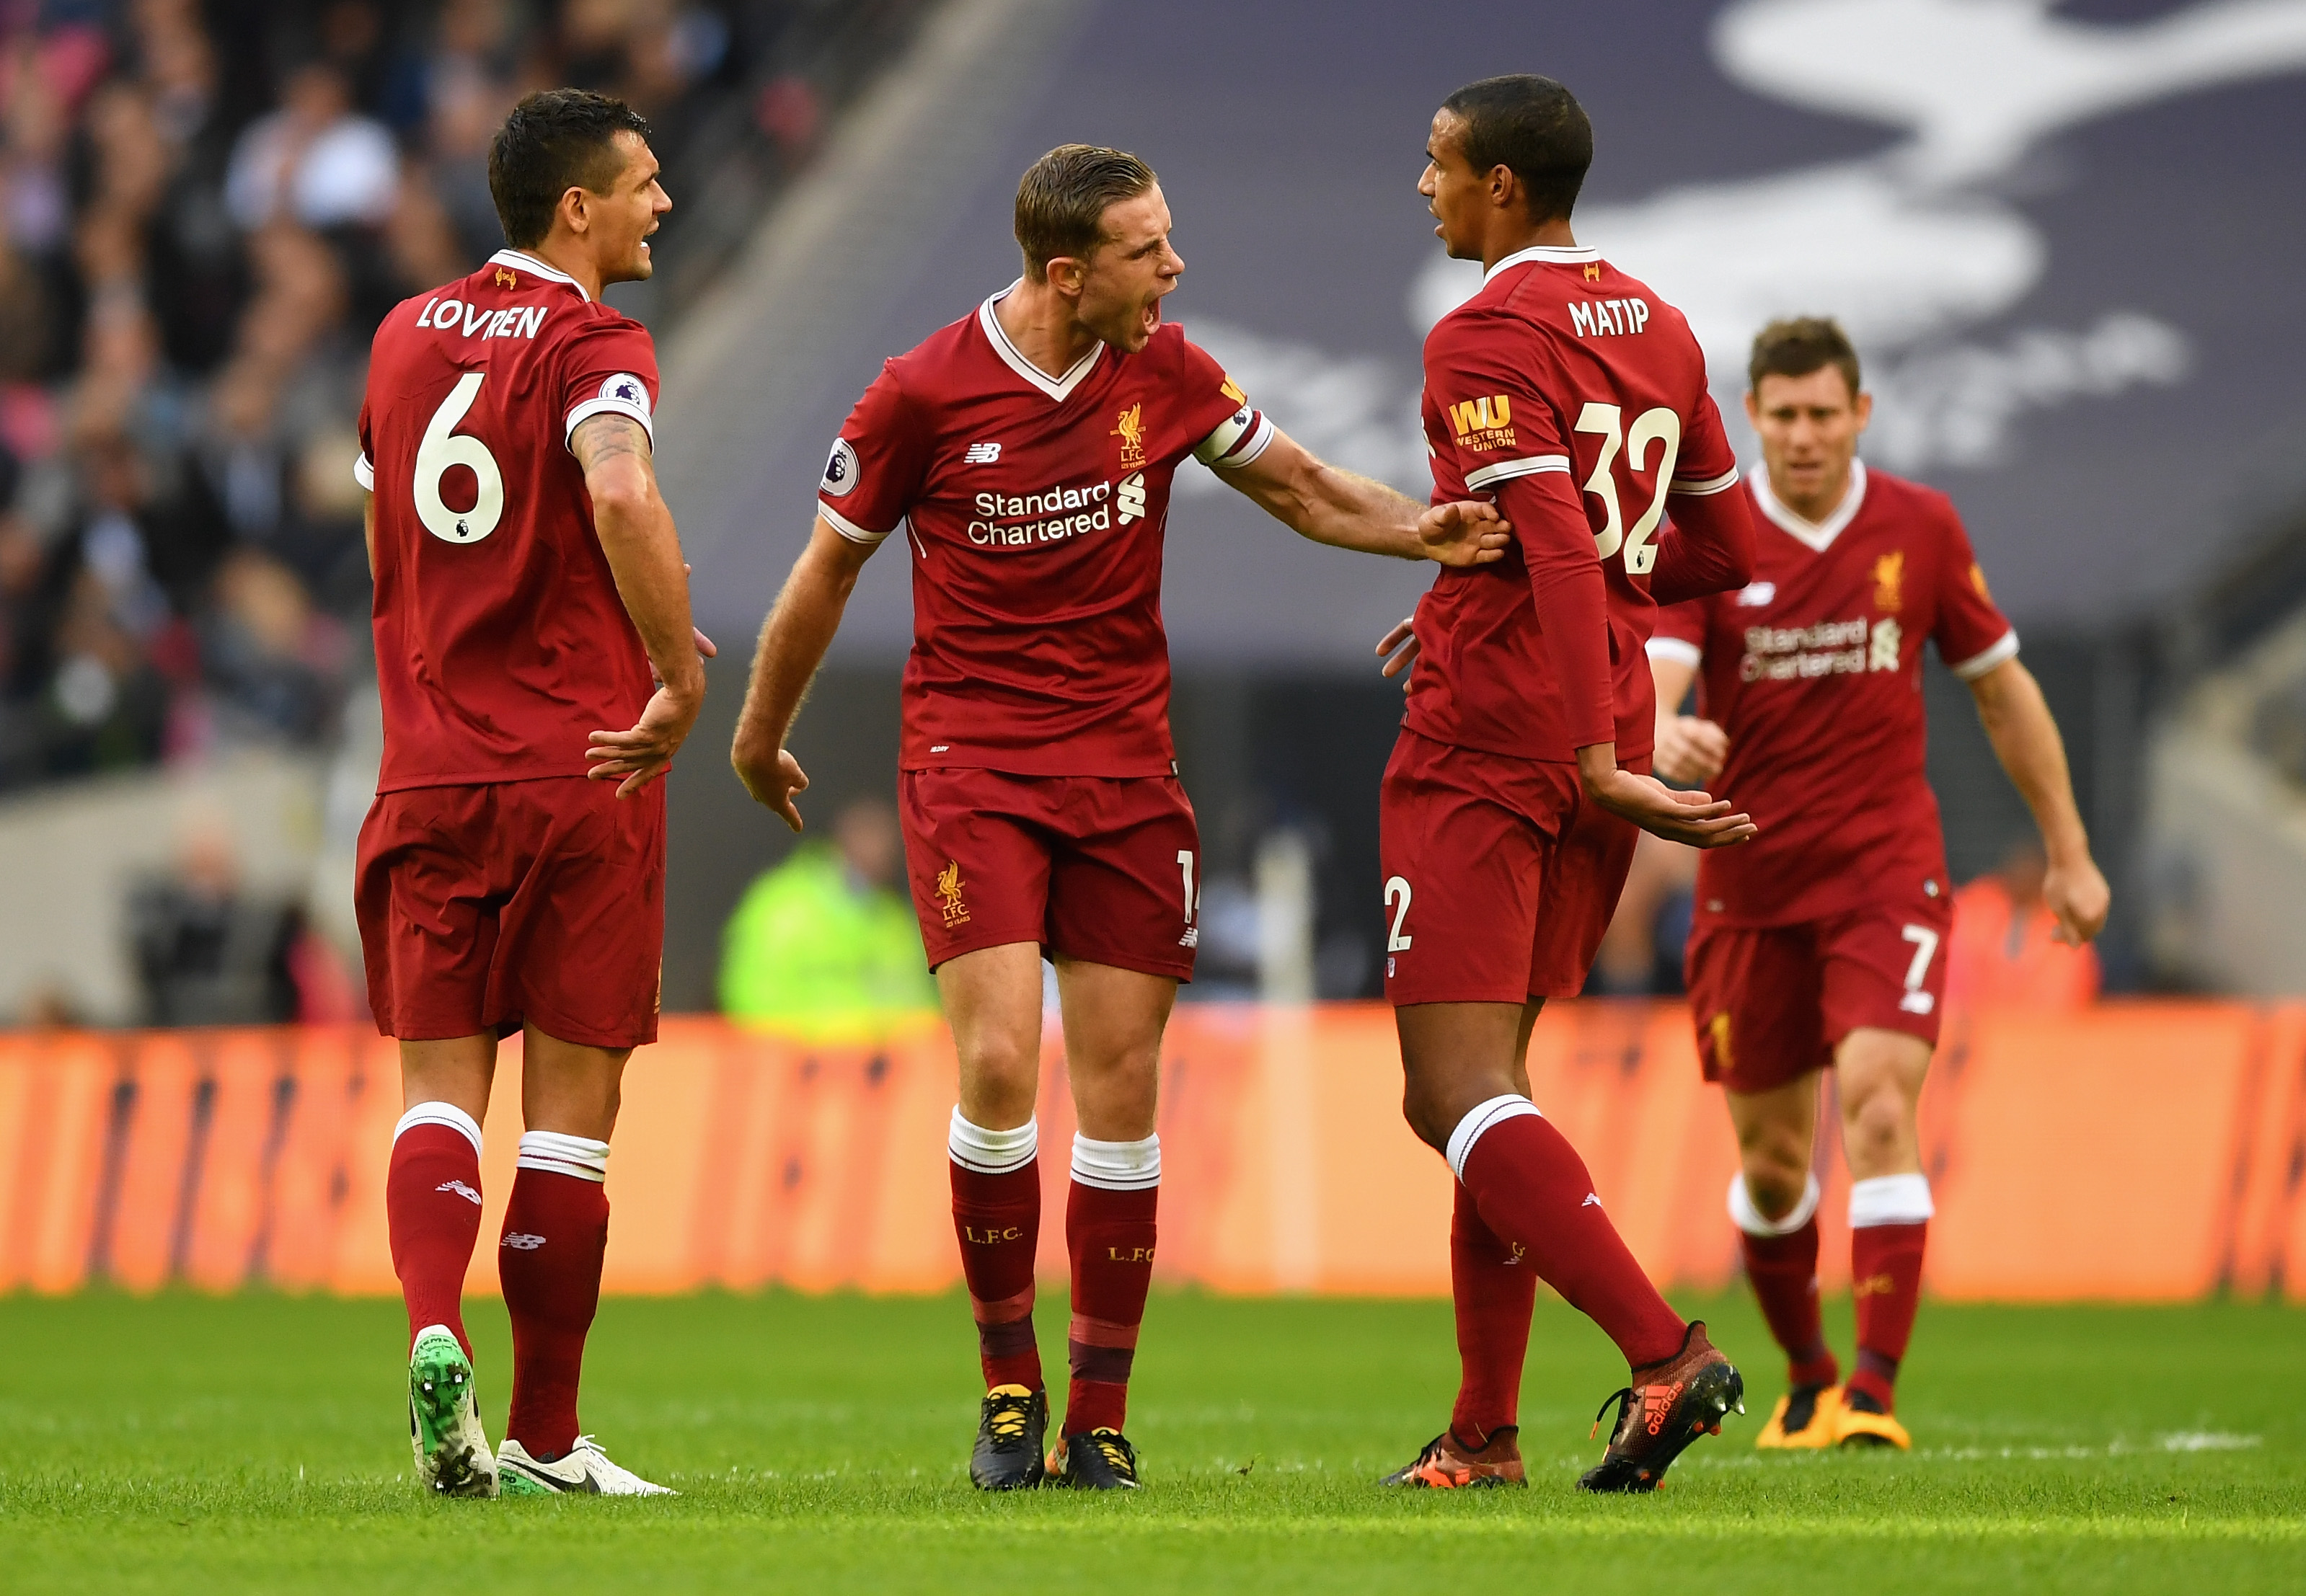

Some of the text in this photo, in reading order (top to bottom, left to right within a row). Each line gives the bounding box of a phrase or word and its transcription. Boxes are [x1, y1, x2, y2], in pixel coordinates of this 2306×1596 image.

[416, 297, 548, 342] LOVREN
[1567, 297, 1650, 337] MATIP
[1449, 394, 1511, 436] WU
[1455, 427, 1515, 446] WESTERN
[1473, 438, 1516, 452] UNION
[413, 372, 504, 544] 6
[976, 481, 1110, 518] Standard
[1573, 402, 1681, 575] 32
[968, 504, 1110, 546] Chartered
[1744, 616, 1868, 654] Standard
[1739, 646, 1867, 683] Chartered
[1901, 924, 1940, 990] 7
[1648, 1380, 1684, 1435] adidas
